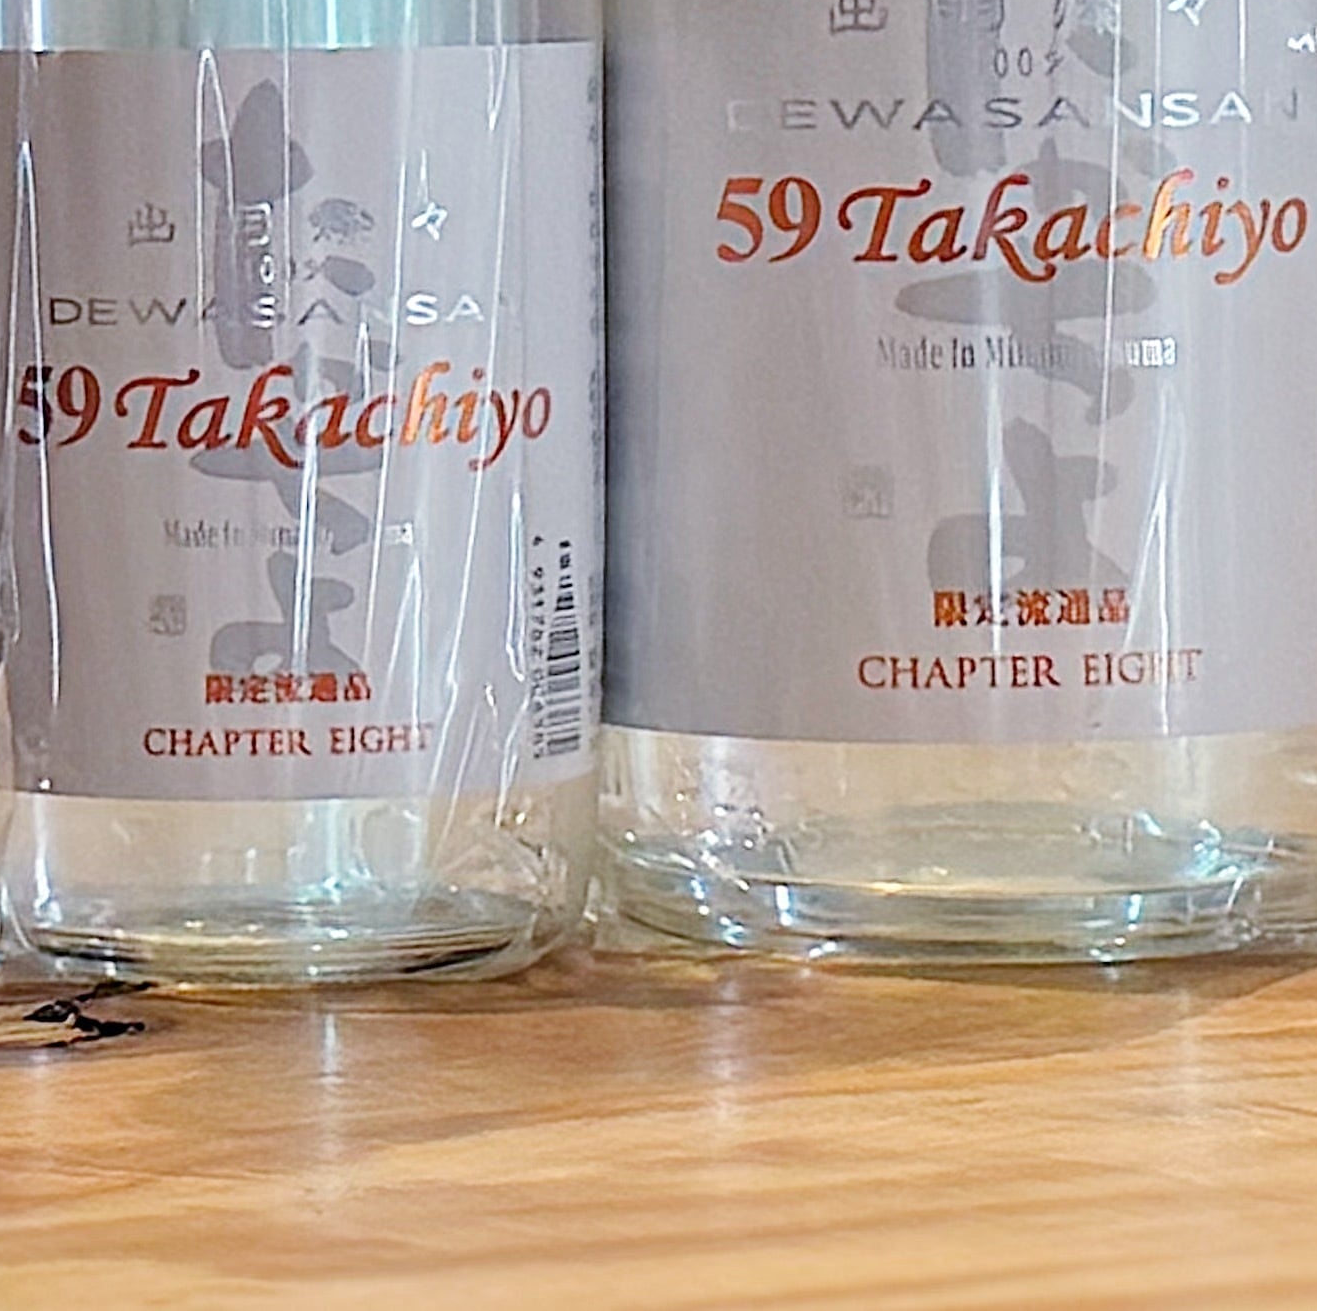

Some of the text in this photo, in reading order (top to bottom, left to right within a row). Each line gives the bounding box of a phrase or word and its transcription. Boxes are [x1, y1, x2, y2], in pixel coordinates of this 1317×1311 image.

[837, 167, 1309, 285] Takachiyo
[878, 337, 944, 370] Made
[114, 360, 552, 471] Takachiyo
[857, 648, 1203, 690] CHAPTER EIGHT
[143, 723, 433, 757] CHAPTER EIGHT
